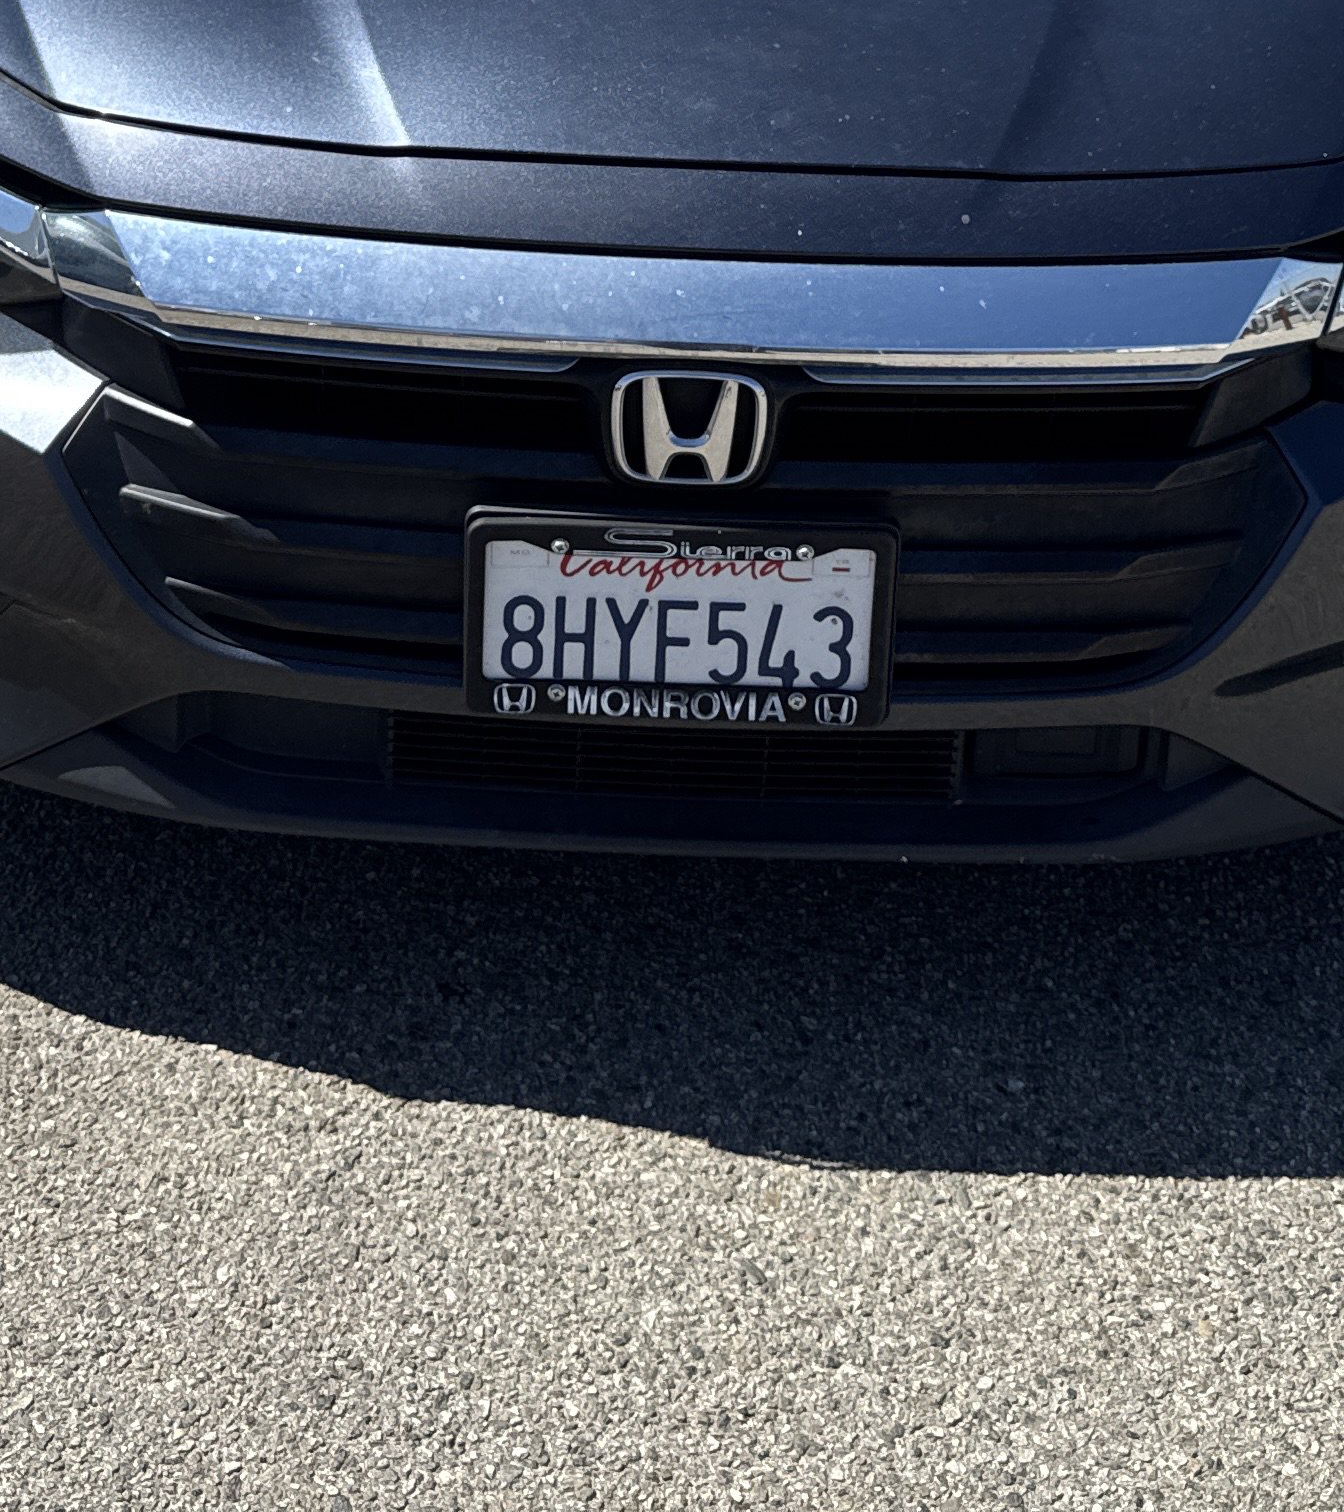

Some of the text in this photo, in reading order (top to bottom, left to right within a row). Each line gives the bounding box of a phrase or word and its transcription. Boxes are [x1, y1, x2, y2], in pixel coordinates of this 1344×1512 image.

[571, 528, 793, 561] Sierra
[560, 554, 813, 592] California
[500, 594, 855, 689] 8HYF543
[566, 686, 787, 723] MONROVIA
